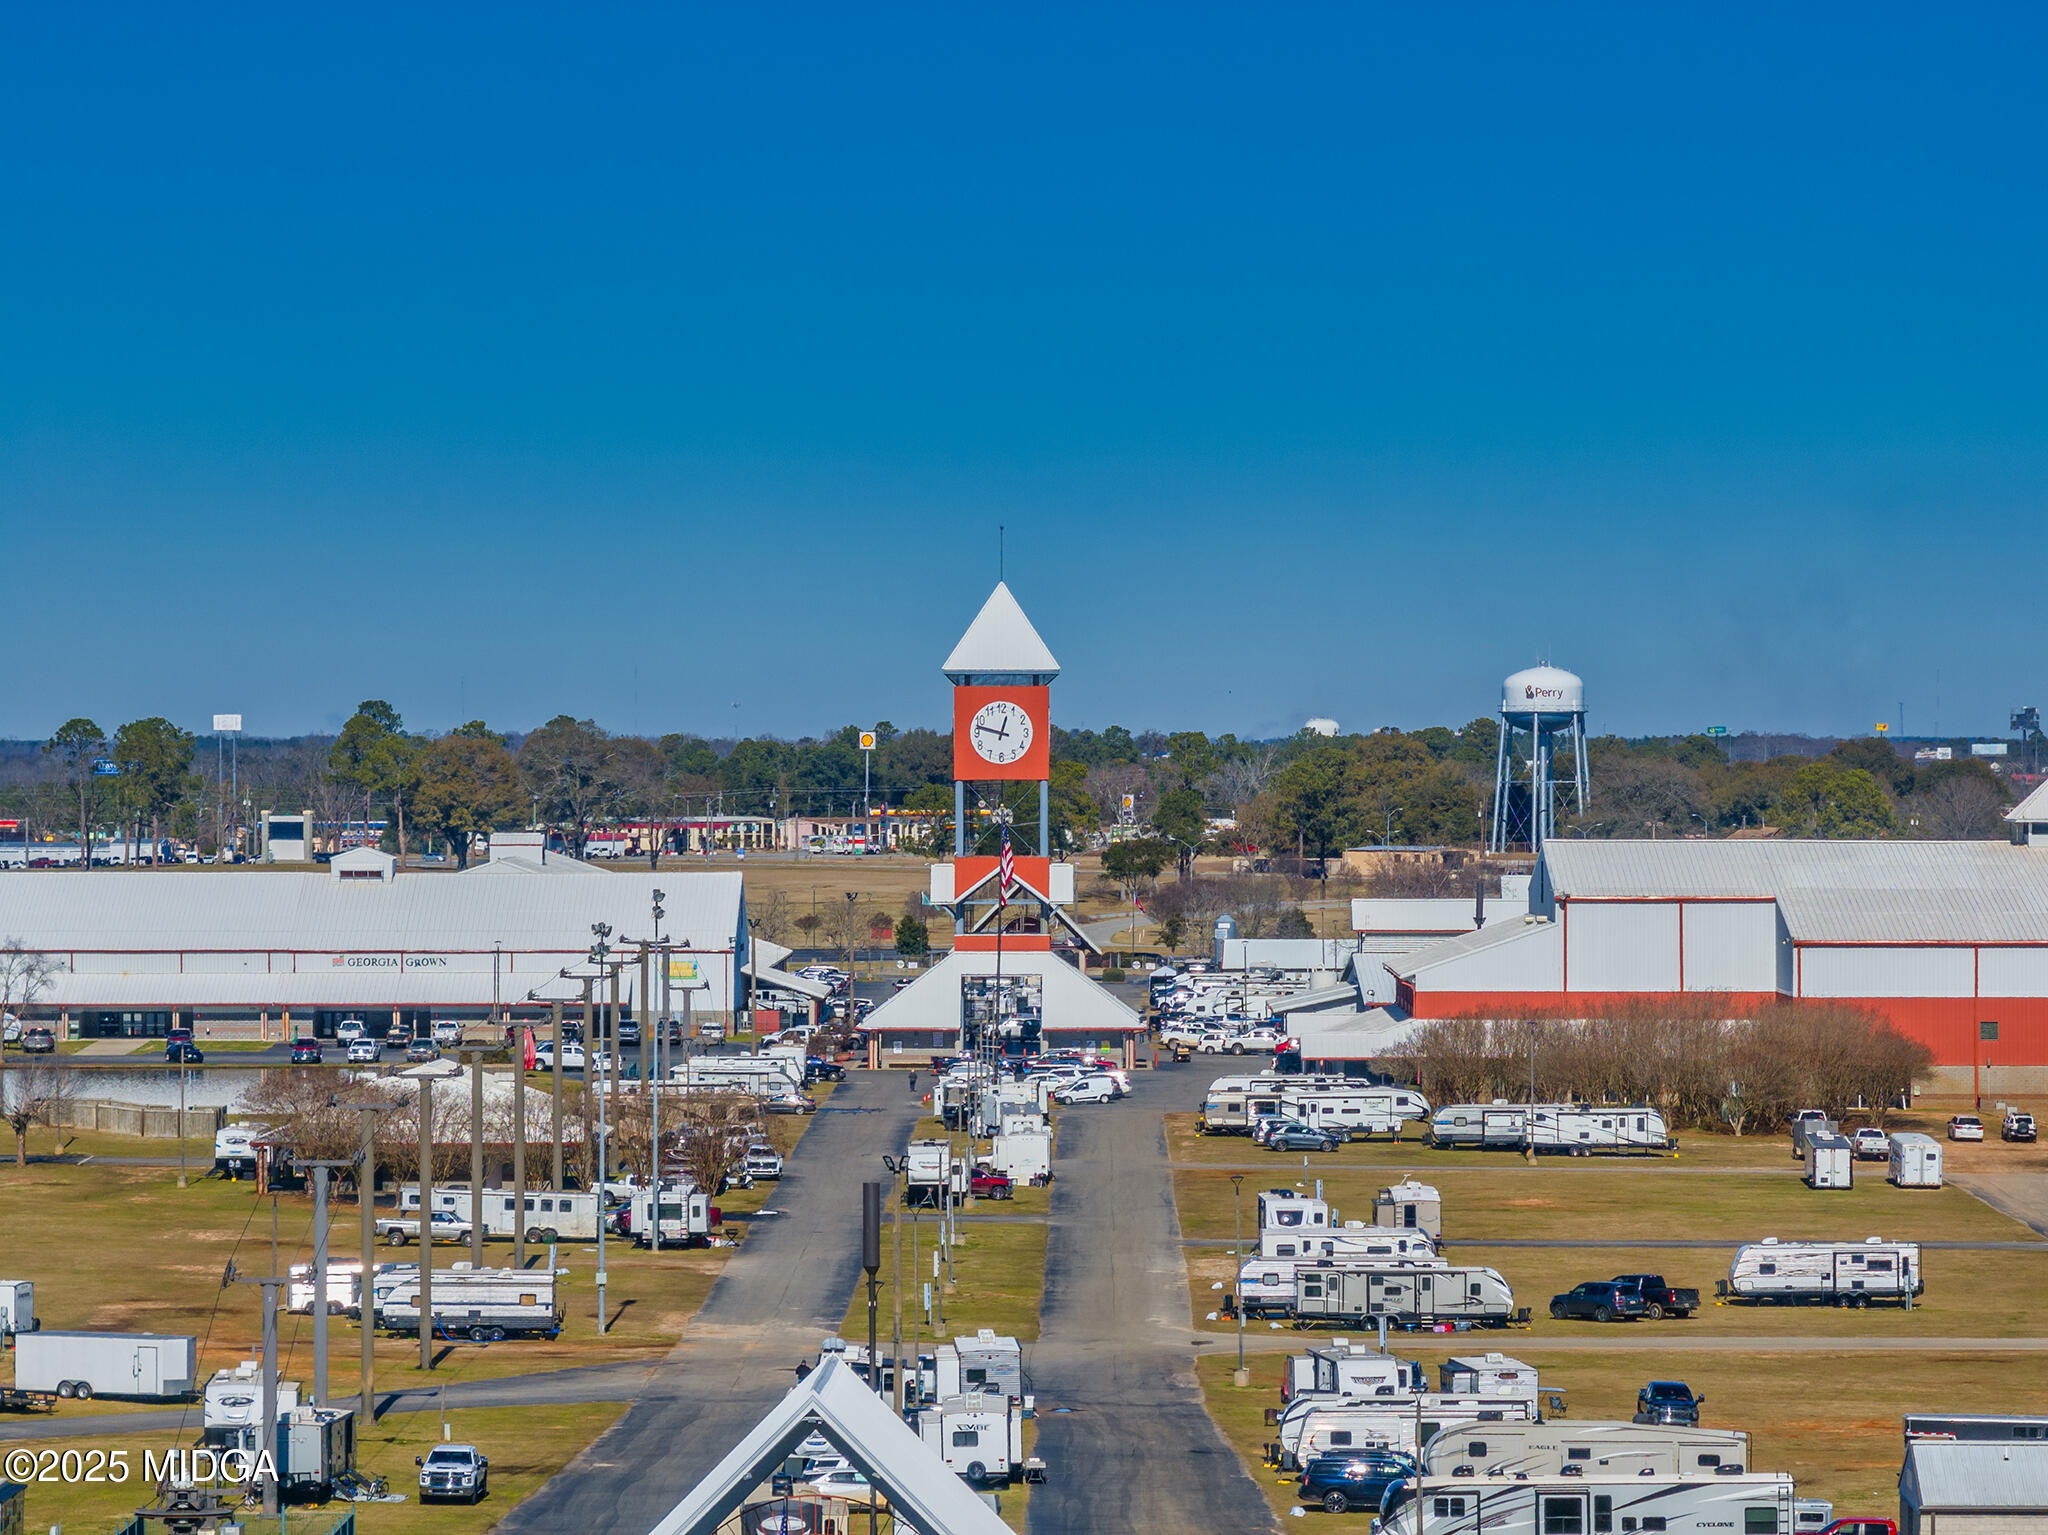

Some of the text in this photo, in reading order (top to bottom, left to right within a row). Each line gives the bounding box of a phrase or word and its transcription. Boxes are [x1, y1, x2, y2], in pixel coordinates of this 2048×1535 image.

[1535, 687, 1564, 700] Perry
[986, 706, 994, 716] 11
[996, 703, 1007, 714] 12
[1011, 706, 1016, 717] 1
[975, 714, 985, 726] 10
[1020, 714, 1026, 725] 2
[974, 728, 980, 738] 9
[1023, 728, 1029, 738] 3
[977, 740, 983, 750] 8
[1019, 740, 1025, 750] 4
[987, 749, 993, 760] 7
[999, 752, 1005, 763] 6
[1010, 749, 1017, 760] 5
[347, 957, 448, 967] GEORGIA GROWN
